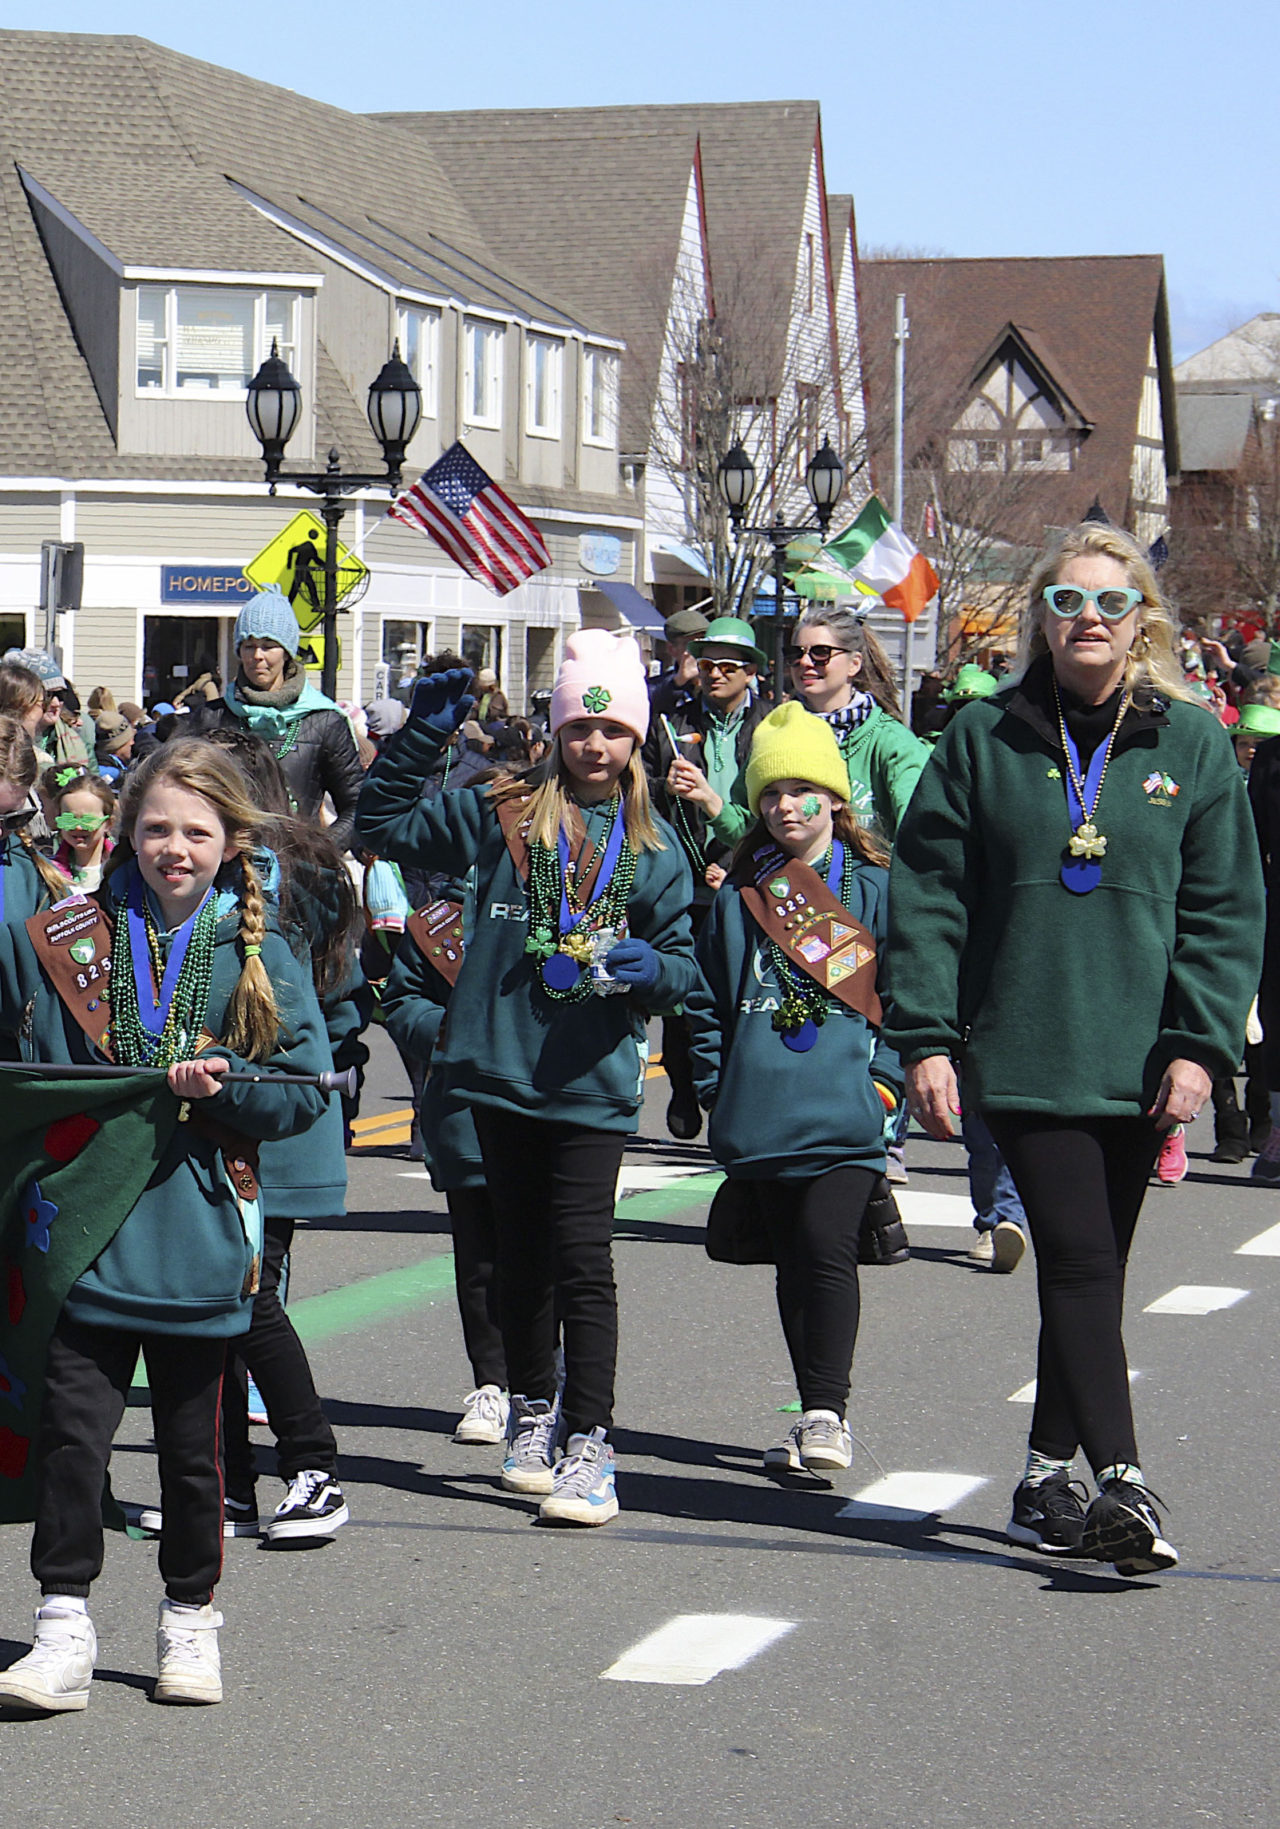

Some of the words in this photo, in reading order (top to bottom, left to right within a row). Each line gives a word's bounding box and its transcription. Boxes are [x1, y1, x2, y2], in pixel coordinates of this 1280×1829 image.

[775, 893, 806, 917] 825
[75, 916, 98, 931] COUNTY
[77, 957, 112, 988] 825
